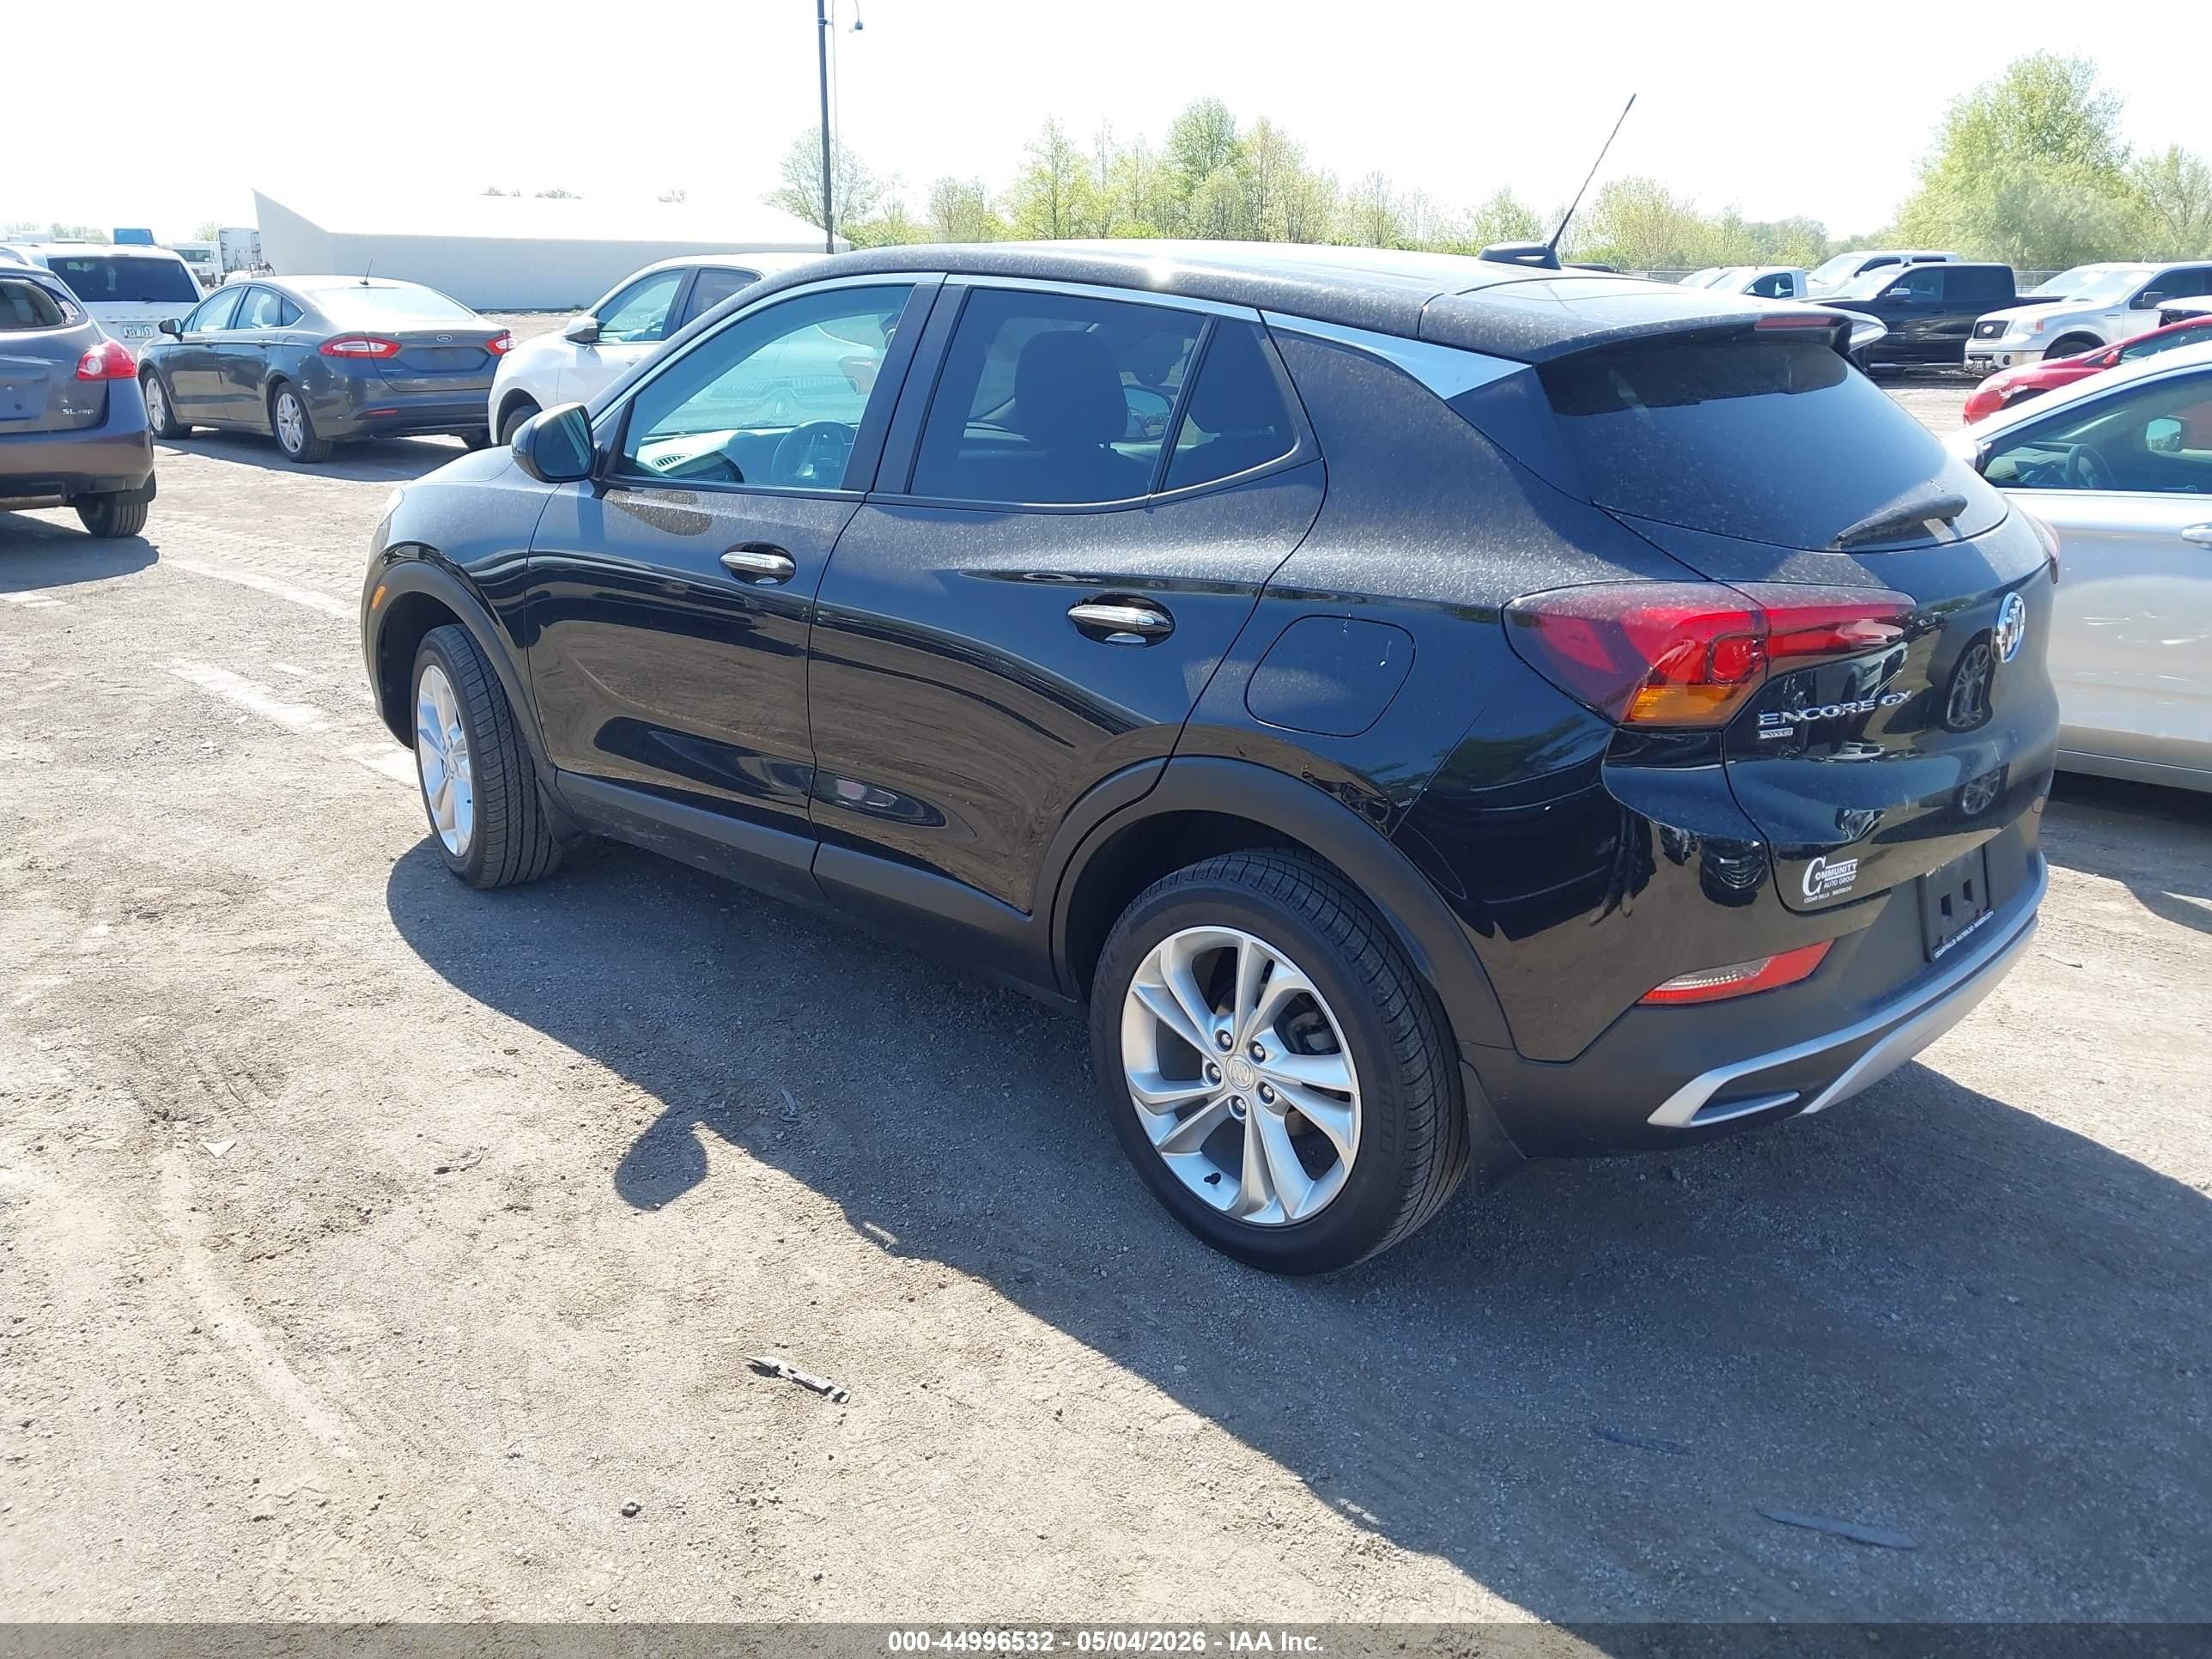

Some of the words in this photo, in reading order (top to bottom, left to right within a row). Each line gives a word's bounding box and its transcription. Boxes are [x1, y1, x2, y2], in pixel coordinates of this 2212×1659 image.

[1758, 699, 1875, 726] ENCORE
[1881, 690, 1912, 707] GX
[1824, 879, 1838, 888] AUTO
[1838, 874, 1856, 884] GROUP
